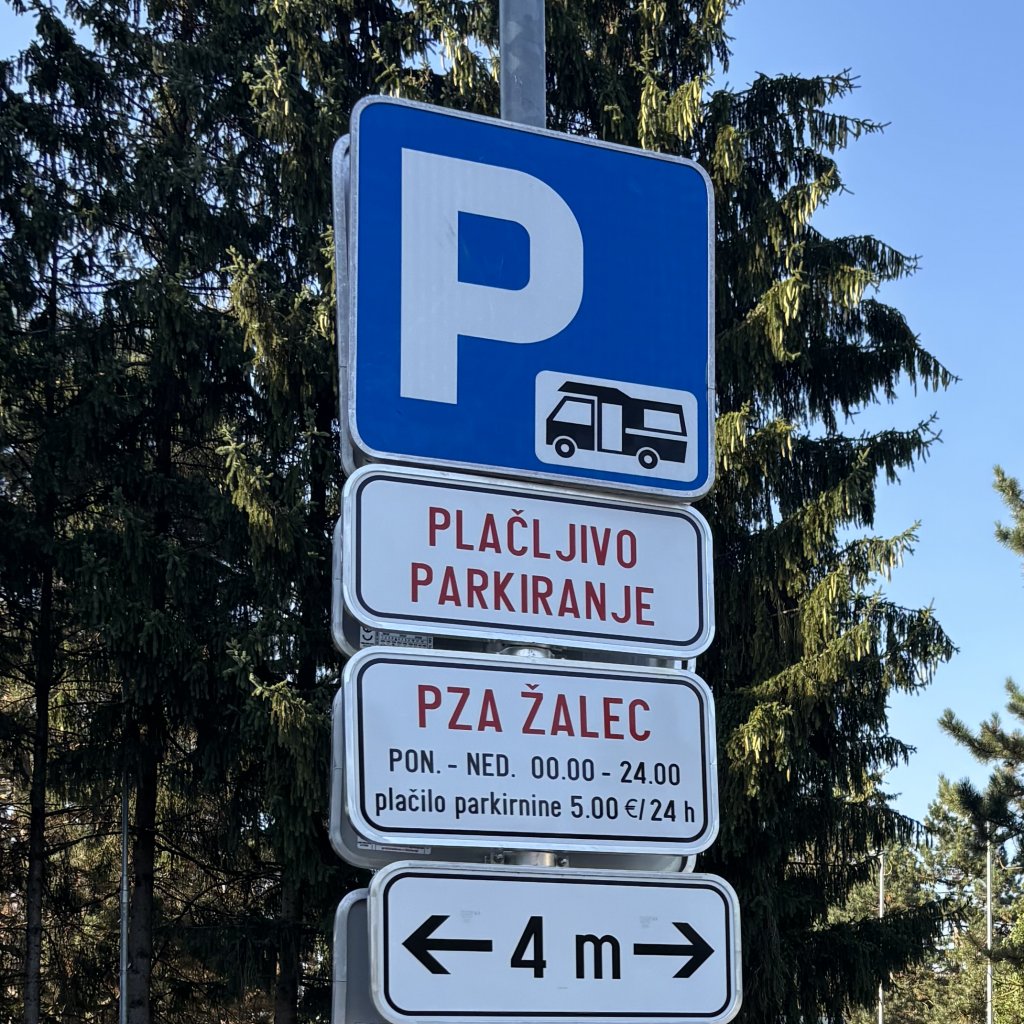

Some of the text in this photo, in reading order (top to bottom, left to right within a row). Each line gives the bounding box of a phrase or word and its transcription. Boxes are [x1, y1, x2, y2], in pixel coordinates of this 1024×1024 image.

[401, 148, 584, 404] P
[429, 507, 637, 569] PLAČLJIVO
[411, 562, 655, 626] PARKIRANJE
[418, 684, 651, 741] PZA ŽALEC
[389, 748, 441, 774] PON.
[466, 752, 516, 778] NED.
[531, 755, 595, 782] 00.00
[619, 760, 681, 786] 24.00
[375, 787, 446, 817] plačilo
[455, 792, 562, 820] parkirnine
[684, 801, 695, 823] h
[511, 916, 620, 979] 4 m
